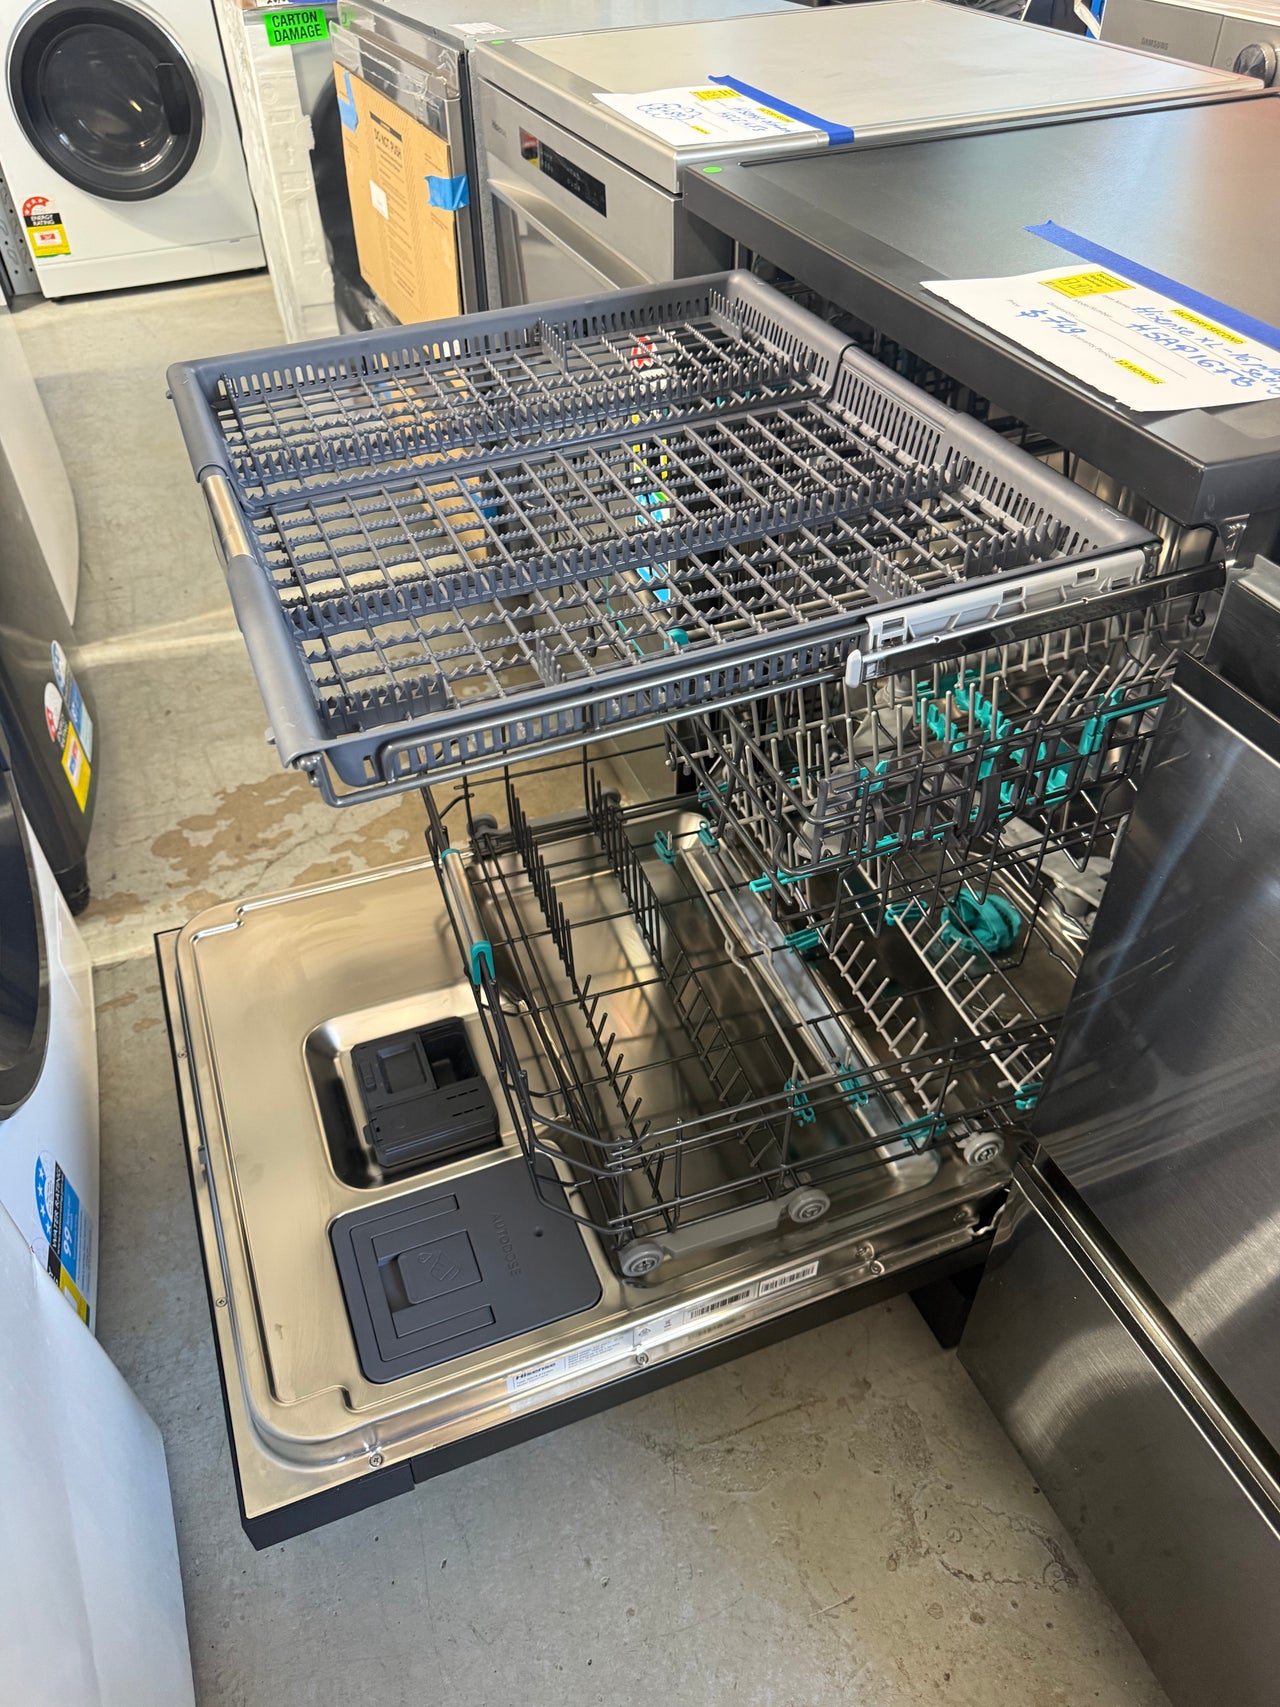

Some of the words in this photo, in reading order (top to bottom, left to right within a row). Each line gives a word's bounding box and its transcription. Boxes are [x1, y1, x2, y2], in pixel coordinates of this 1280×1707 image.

[272, 11, 318, 28] CARTON
[273, 24, 322, 42] DAMAGE
[1141, 37, 1169, 50] SAMSUNG
[1132, 307, 1196, 337] Hisense
[1170, 309, 1211, 327] FACTORY
[1205, 327, 1245, 344] SECOND
[1123, 365, 1164, 384] MONTHS
[54, 1166, 62, 1209] RATING
[52, 1209, 60, 1249] WATER
[63, 1226, 73, 1258] 99
[490, 1213, 521, 1278] AUTODOSE
[515, 1362, 557, 1381] Hisense
